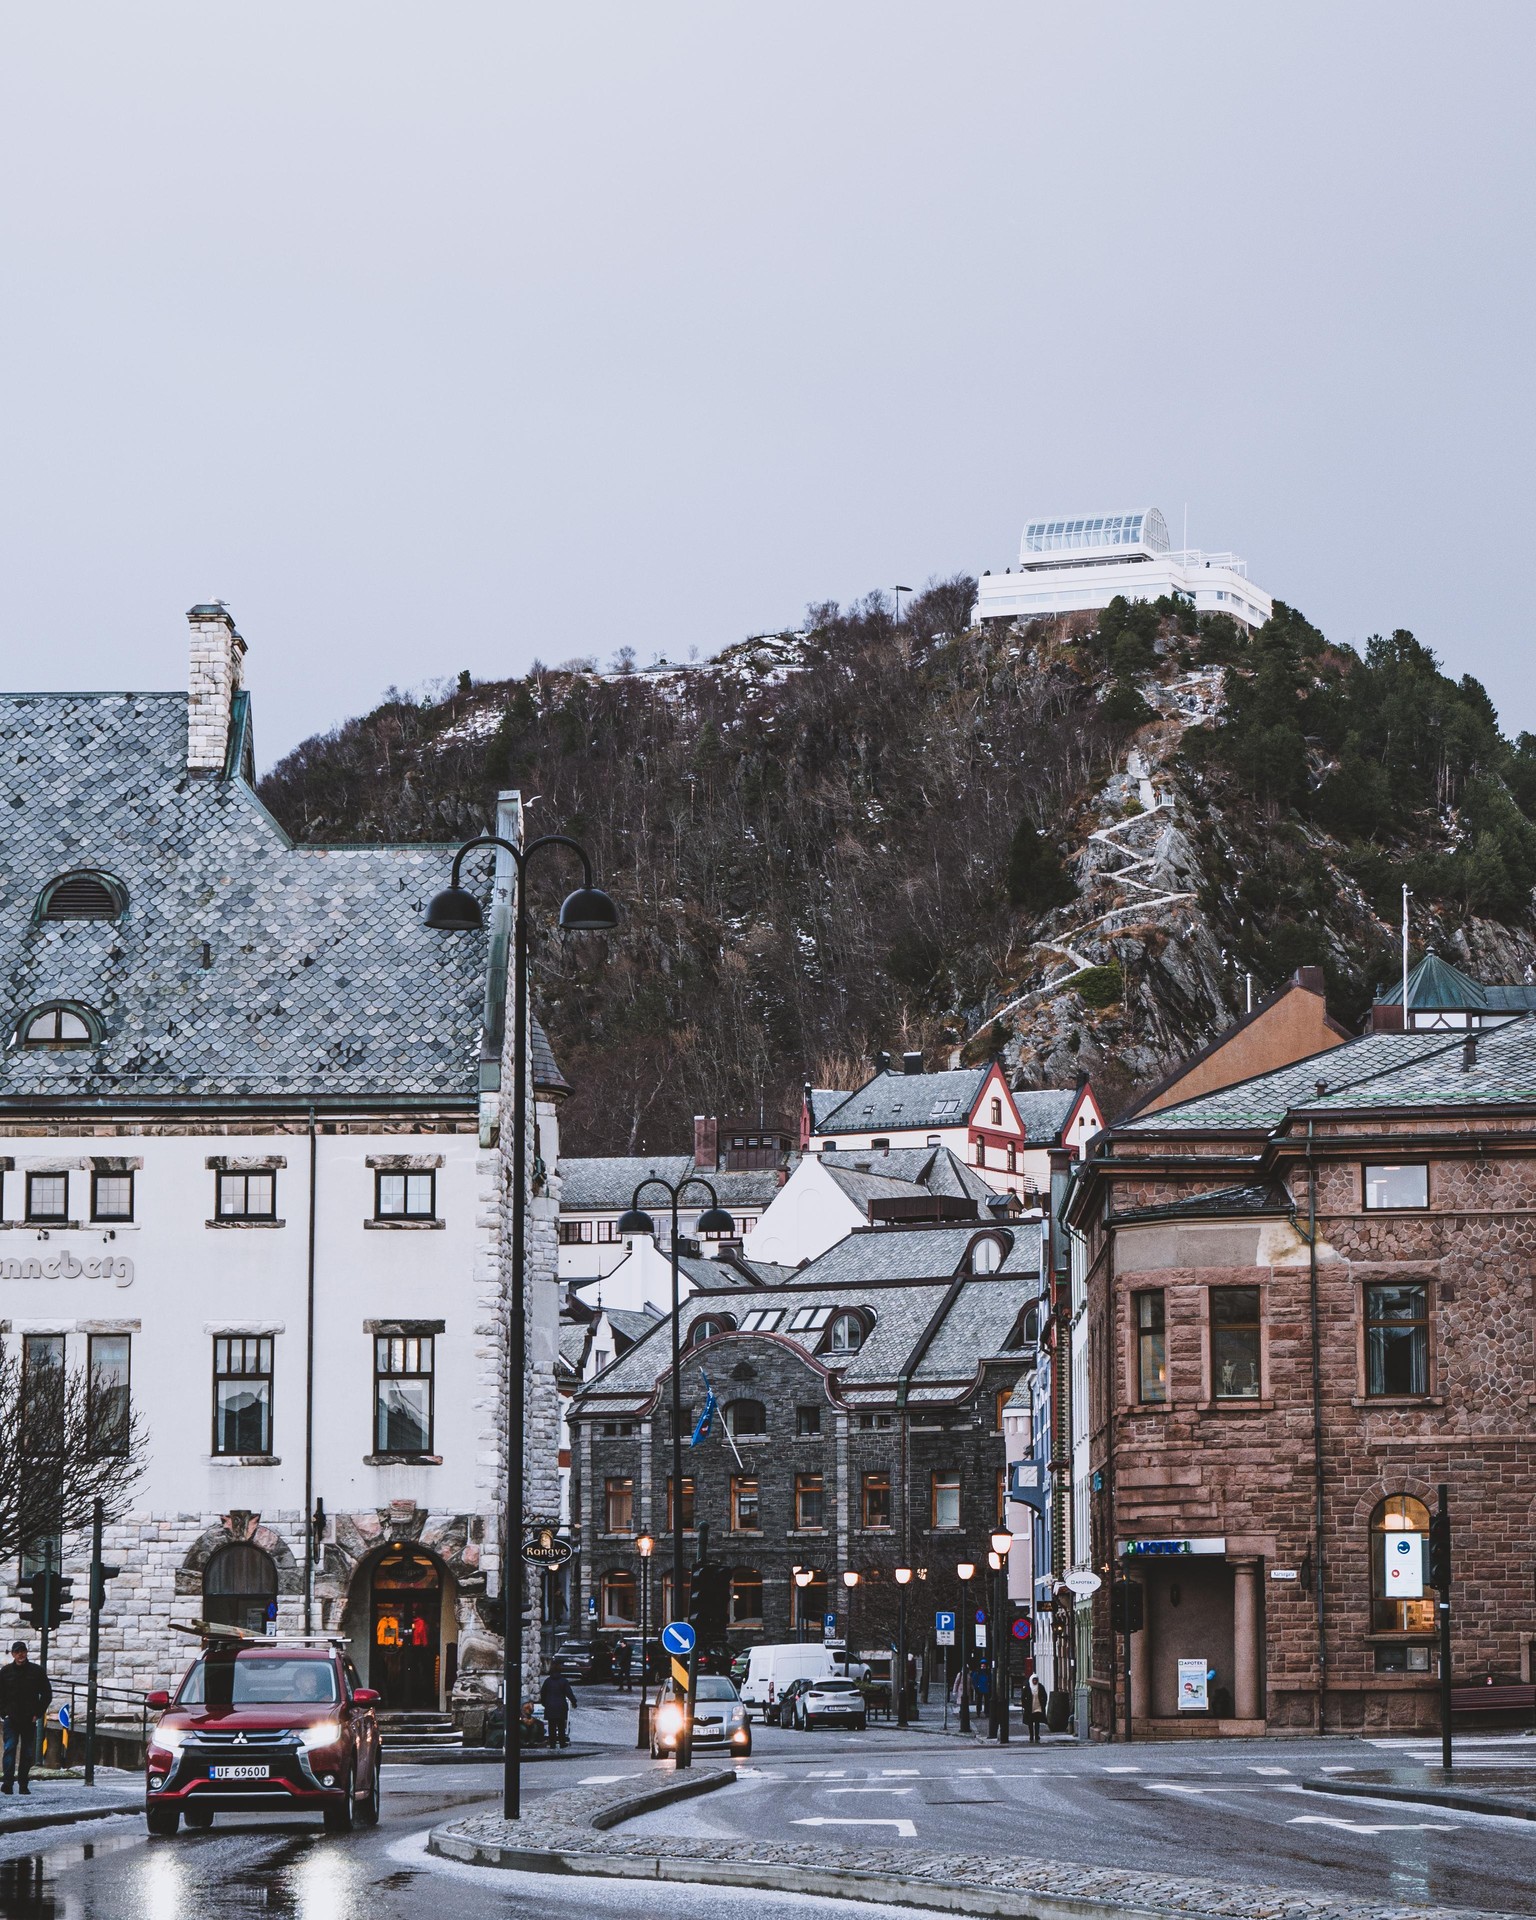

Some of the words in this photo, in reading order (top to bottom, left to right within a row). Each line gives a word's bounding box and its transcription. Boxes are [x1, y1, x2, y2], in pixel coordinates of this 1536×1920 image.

[0, 1250, 134, 1288] nneberg
[526, 1547, 567, 1558] Rongve
[1136, 1541, 1181, 1553] APOTEK
[1182, 1541, 1190, 1553] 1
[827, 1615, 834, 1626] P
[941, 1614, 951, 1629] P
[217, 1767, 230, 1777] UF
[234, 1766, 267, 1777] 69600
